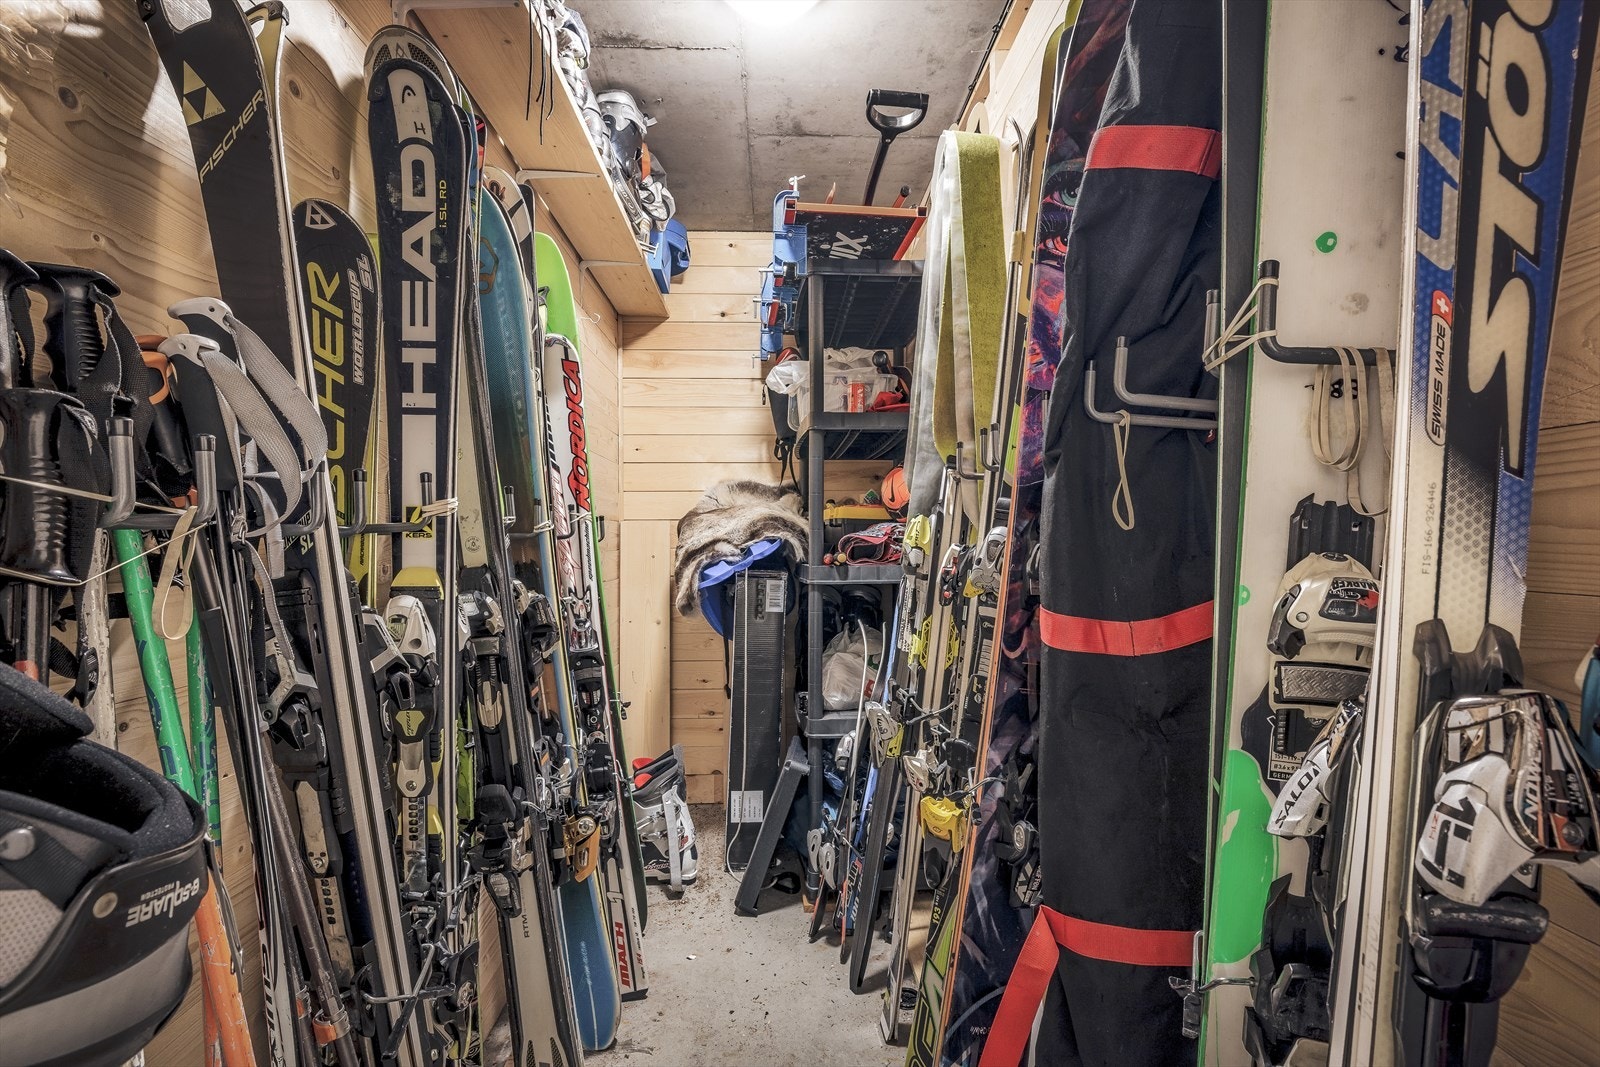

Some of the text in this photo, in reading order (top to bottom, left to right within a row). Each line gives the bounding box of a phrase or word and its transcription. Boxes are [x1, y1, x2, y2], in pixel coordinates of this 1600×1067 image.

[199, 88, 264, 184] FISCHER
[356, 253, 374, 293] SL
[401, 143, 437, 409] HEAD
[1467, 0, 1556, 471] STÖ
[346, 268, 364, 385] WORLDCUP
[306, 262, 345, 513] SCHER
[1431, 322, 1447, 439] SWISS MADE
[561, 358, 591, 512] NORDICA
[1331, 578, 1378, 592] MARKER
[1272, 772, 1291, 780] GERM
[140, 881, 175, 899] PROTECTION
[523, 913, 531, 939] RTM
[932, 906, 942, 925] 193
[614, 921, 631, 989] MACH
